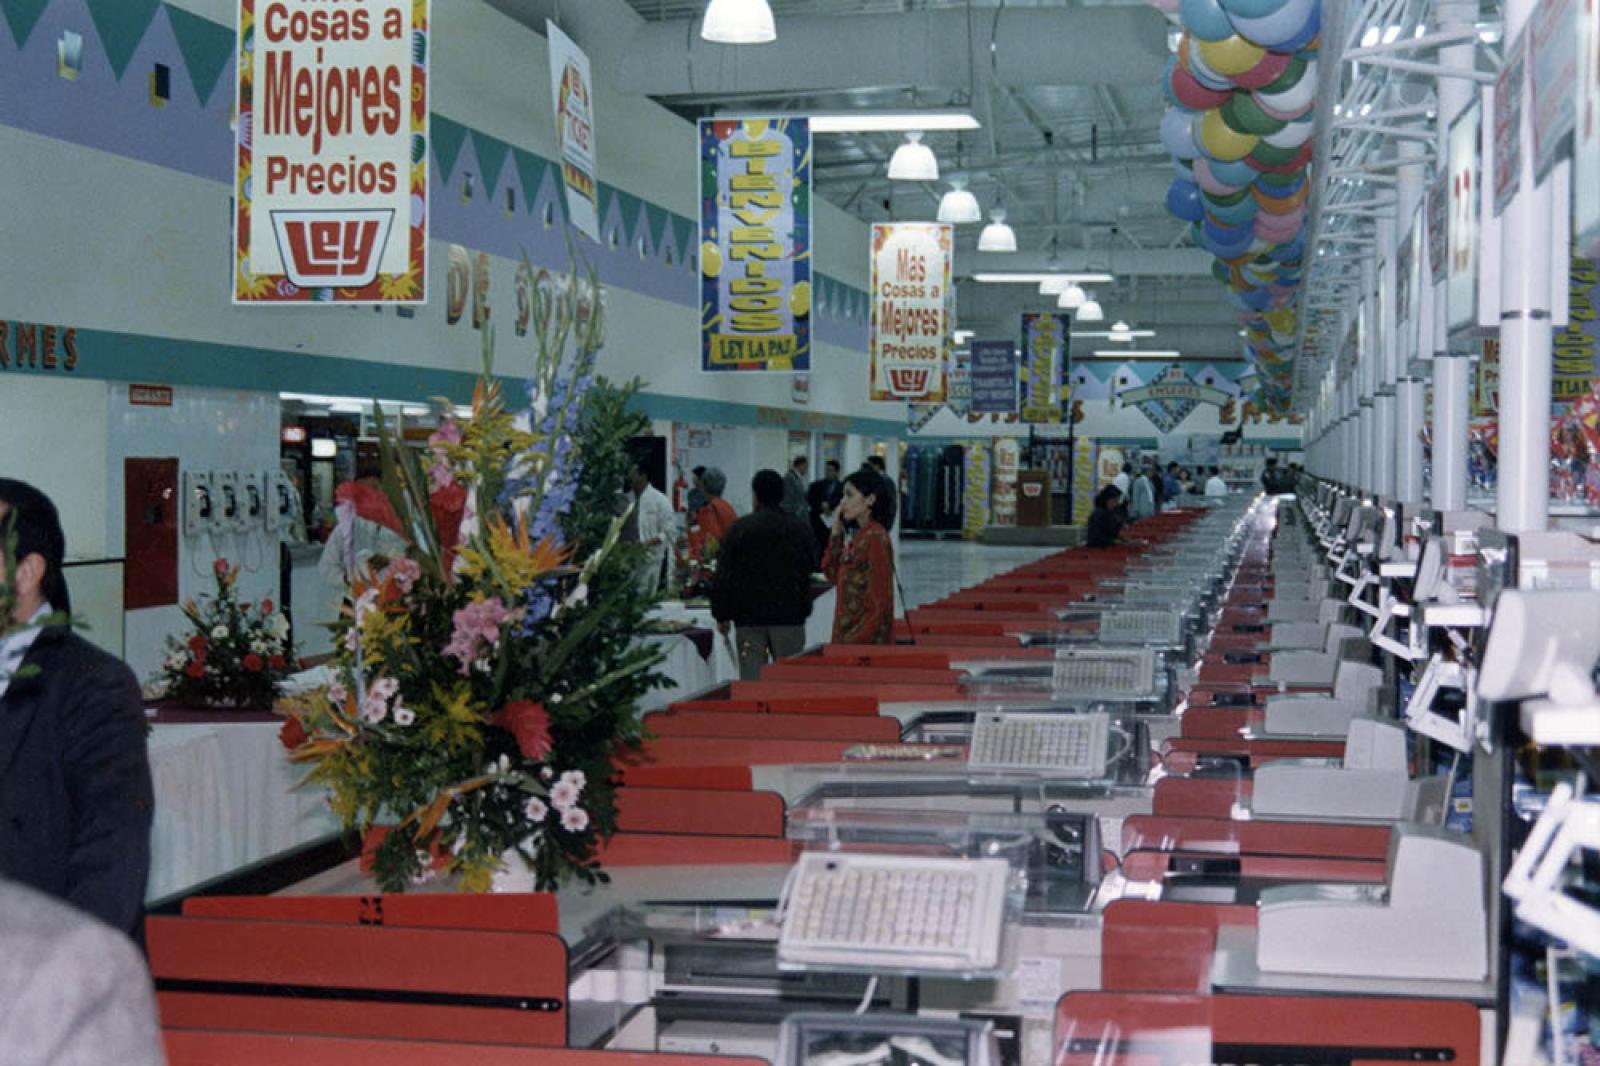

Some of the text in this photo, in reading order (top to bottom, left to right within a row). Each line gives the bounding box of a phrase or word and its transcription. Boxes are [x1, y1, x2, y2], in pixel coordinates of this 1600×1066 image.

[264, 2, 403, 42] Cosas a
[263, 47, 401, 155] Mejores
[266, 155, 397, 194] Precios
[729, 140, 785, 332] BIENVENIDOS
[447, 243, 491, 329] DE
[880, 281, 940, 298] Cosas a
[881, 301, 939, 342] Mejores
[719, 339, 744, 360] LEY
[749, 339, 766, 359] LA
[882, 343, 937, 360] Precios
